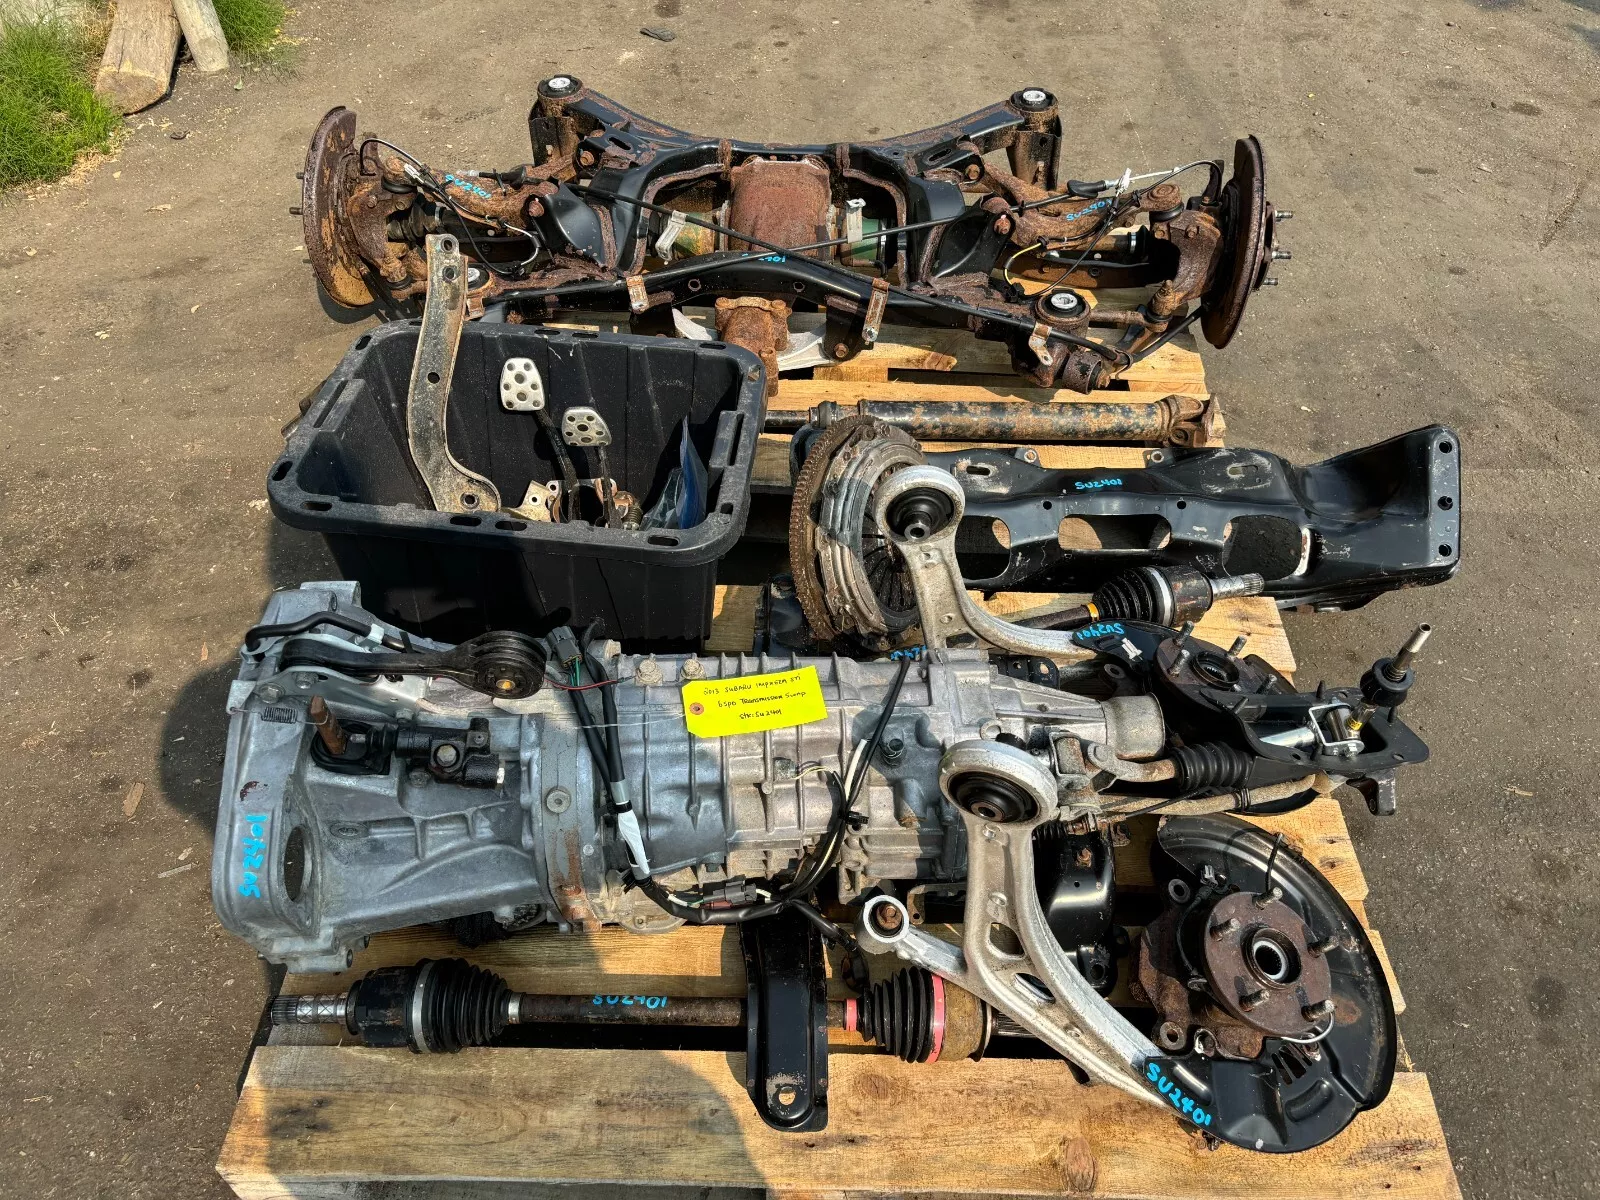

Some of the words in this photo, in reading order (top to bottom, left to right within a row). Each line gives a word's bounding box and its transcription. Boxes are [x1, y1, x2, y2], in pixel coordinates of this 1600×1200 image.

[703, 687, 720, 696] 2013
[238, 814, 268, 899] SU2401
[1146, 1062, 1212, 1126] SU2401
